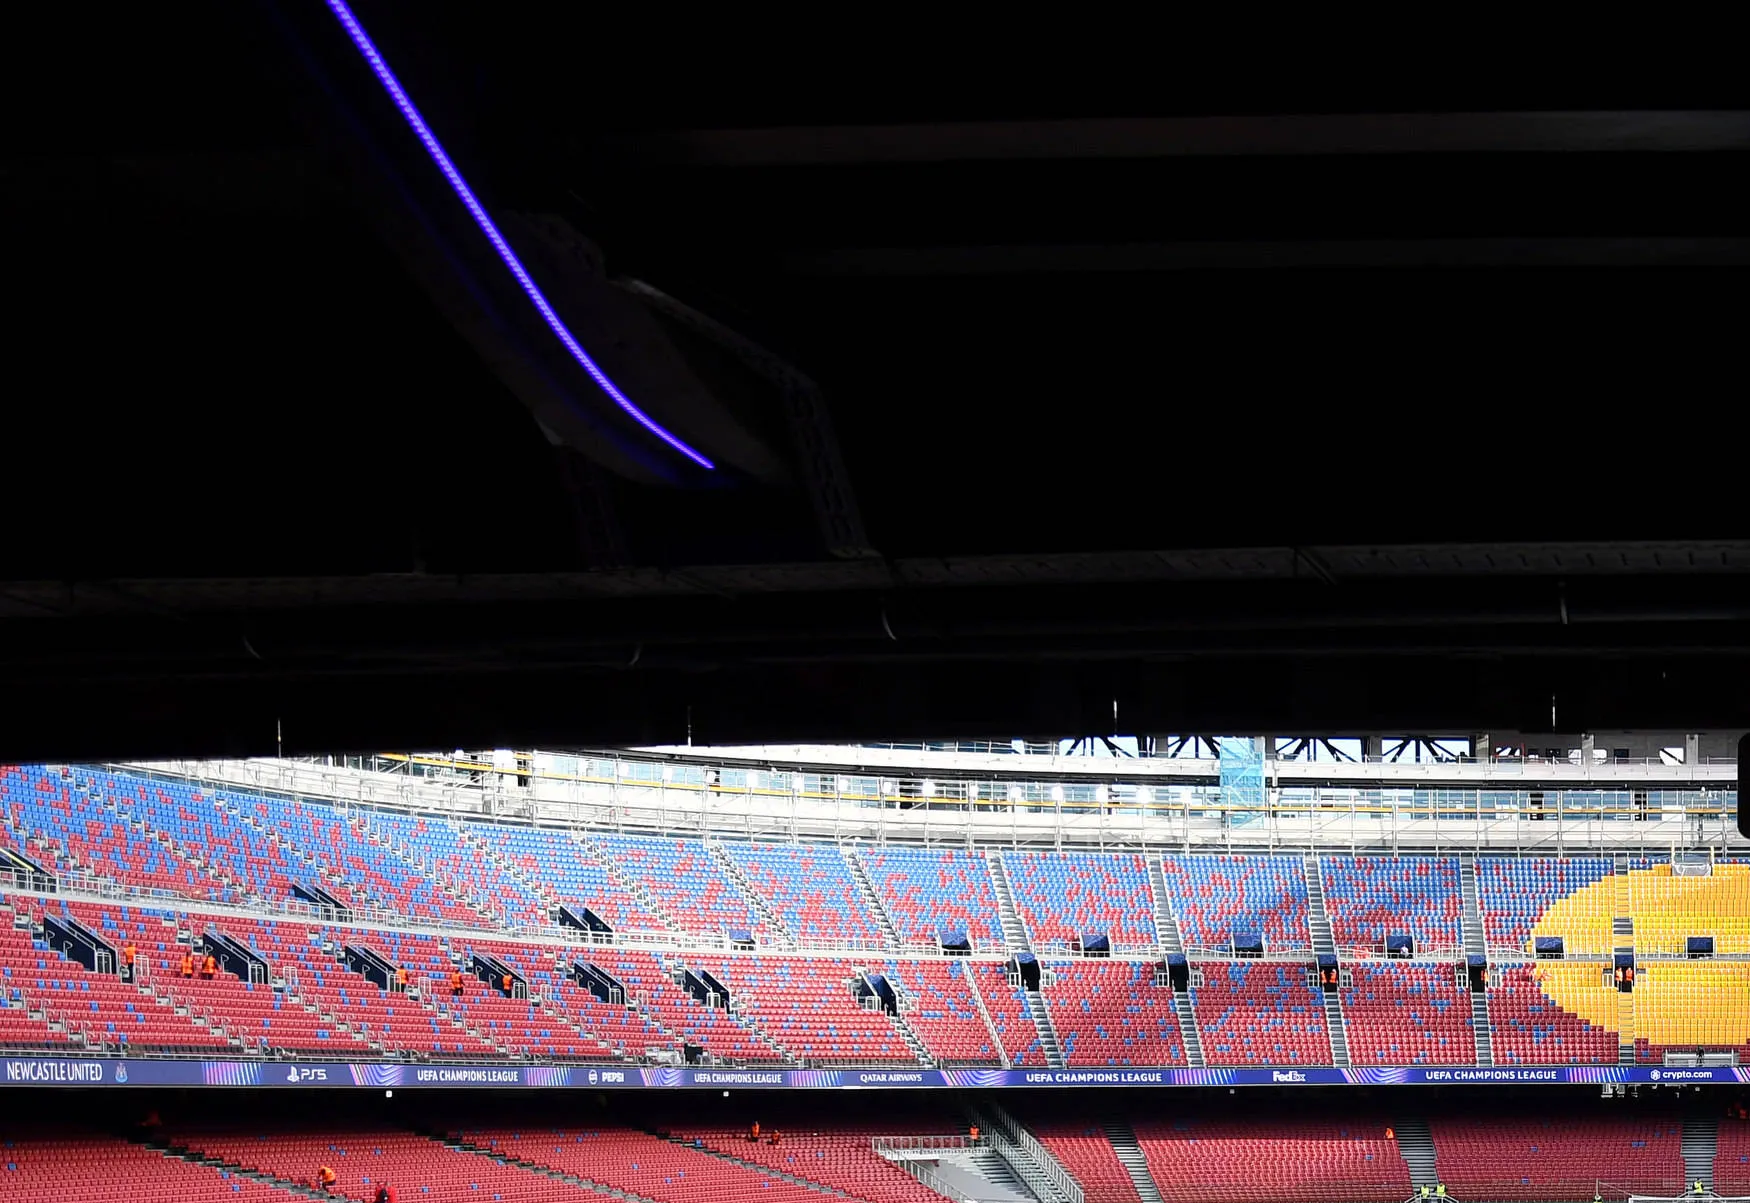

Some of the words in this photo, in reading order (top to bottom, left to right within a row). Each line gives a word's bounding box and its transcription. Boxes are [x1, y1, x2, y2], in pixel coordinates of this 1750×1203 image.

[6, 1061, 67, 1081] NEWCASTLE
[67, 1062, 103, 1081] UNITED
[300, 1068, 328, 1081] PS5
[417, 1070, 439, 1082] UEFA
[440, 1070, 487, 1082] CHAMPIONS
[487, 1070, 519, 1082] LEAGUE
[1272, 1070, 1306, 1082] FedEx
[1425, 1071, 1452, 1080] UEFA
[1454, 1070, 1515, 1080] CHAMPIONS
[1518, 1070, 1557, 1080] LEAGUE
[1662, 1070, 1713, 1080] crypto.com
[601, 1071, 625, 1083] PEPSI
[694, 1074, 712, 1084] UEFA
[712, 1074, 753, 1085] CHAMPIONS
[753, 1074, 782, 1085] LEAGUE
[860, 1073, 888, 1084] QATAR
[888, 1073, 923, 1083] AIRWAYS
[1026, 1073, 1054, 1083] UEFA
[1055, 1073, 1119, 1083] CHAMPIONS
[1121, 1072, 1162, 1083] LEAGUE
